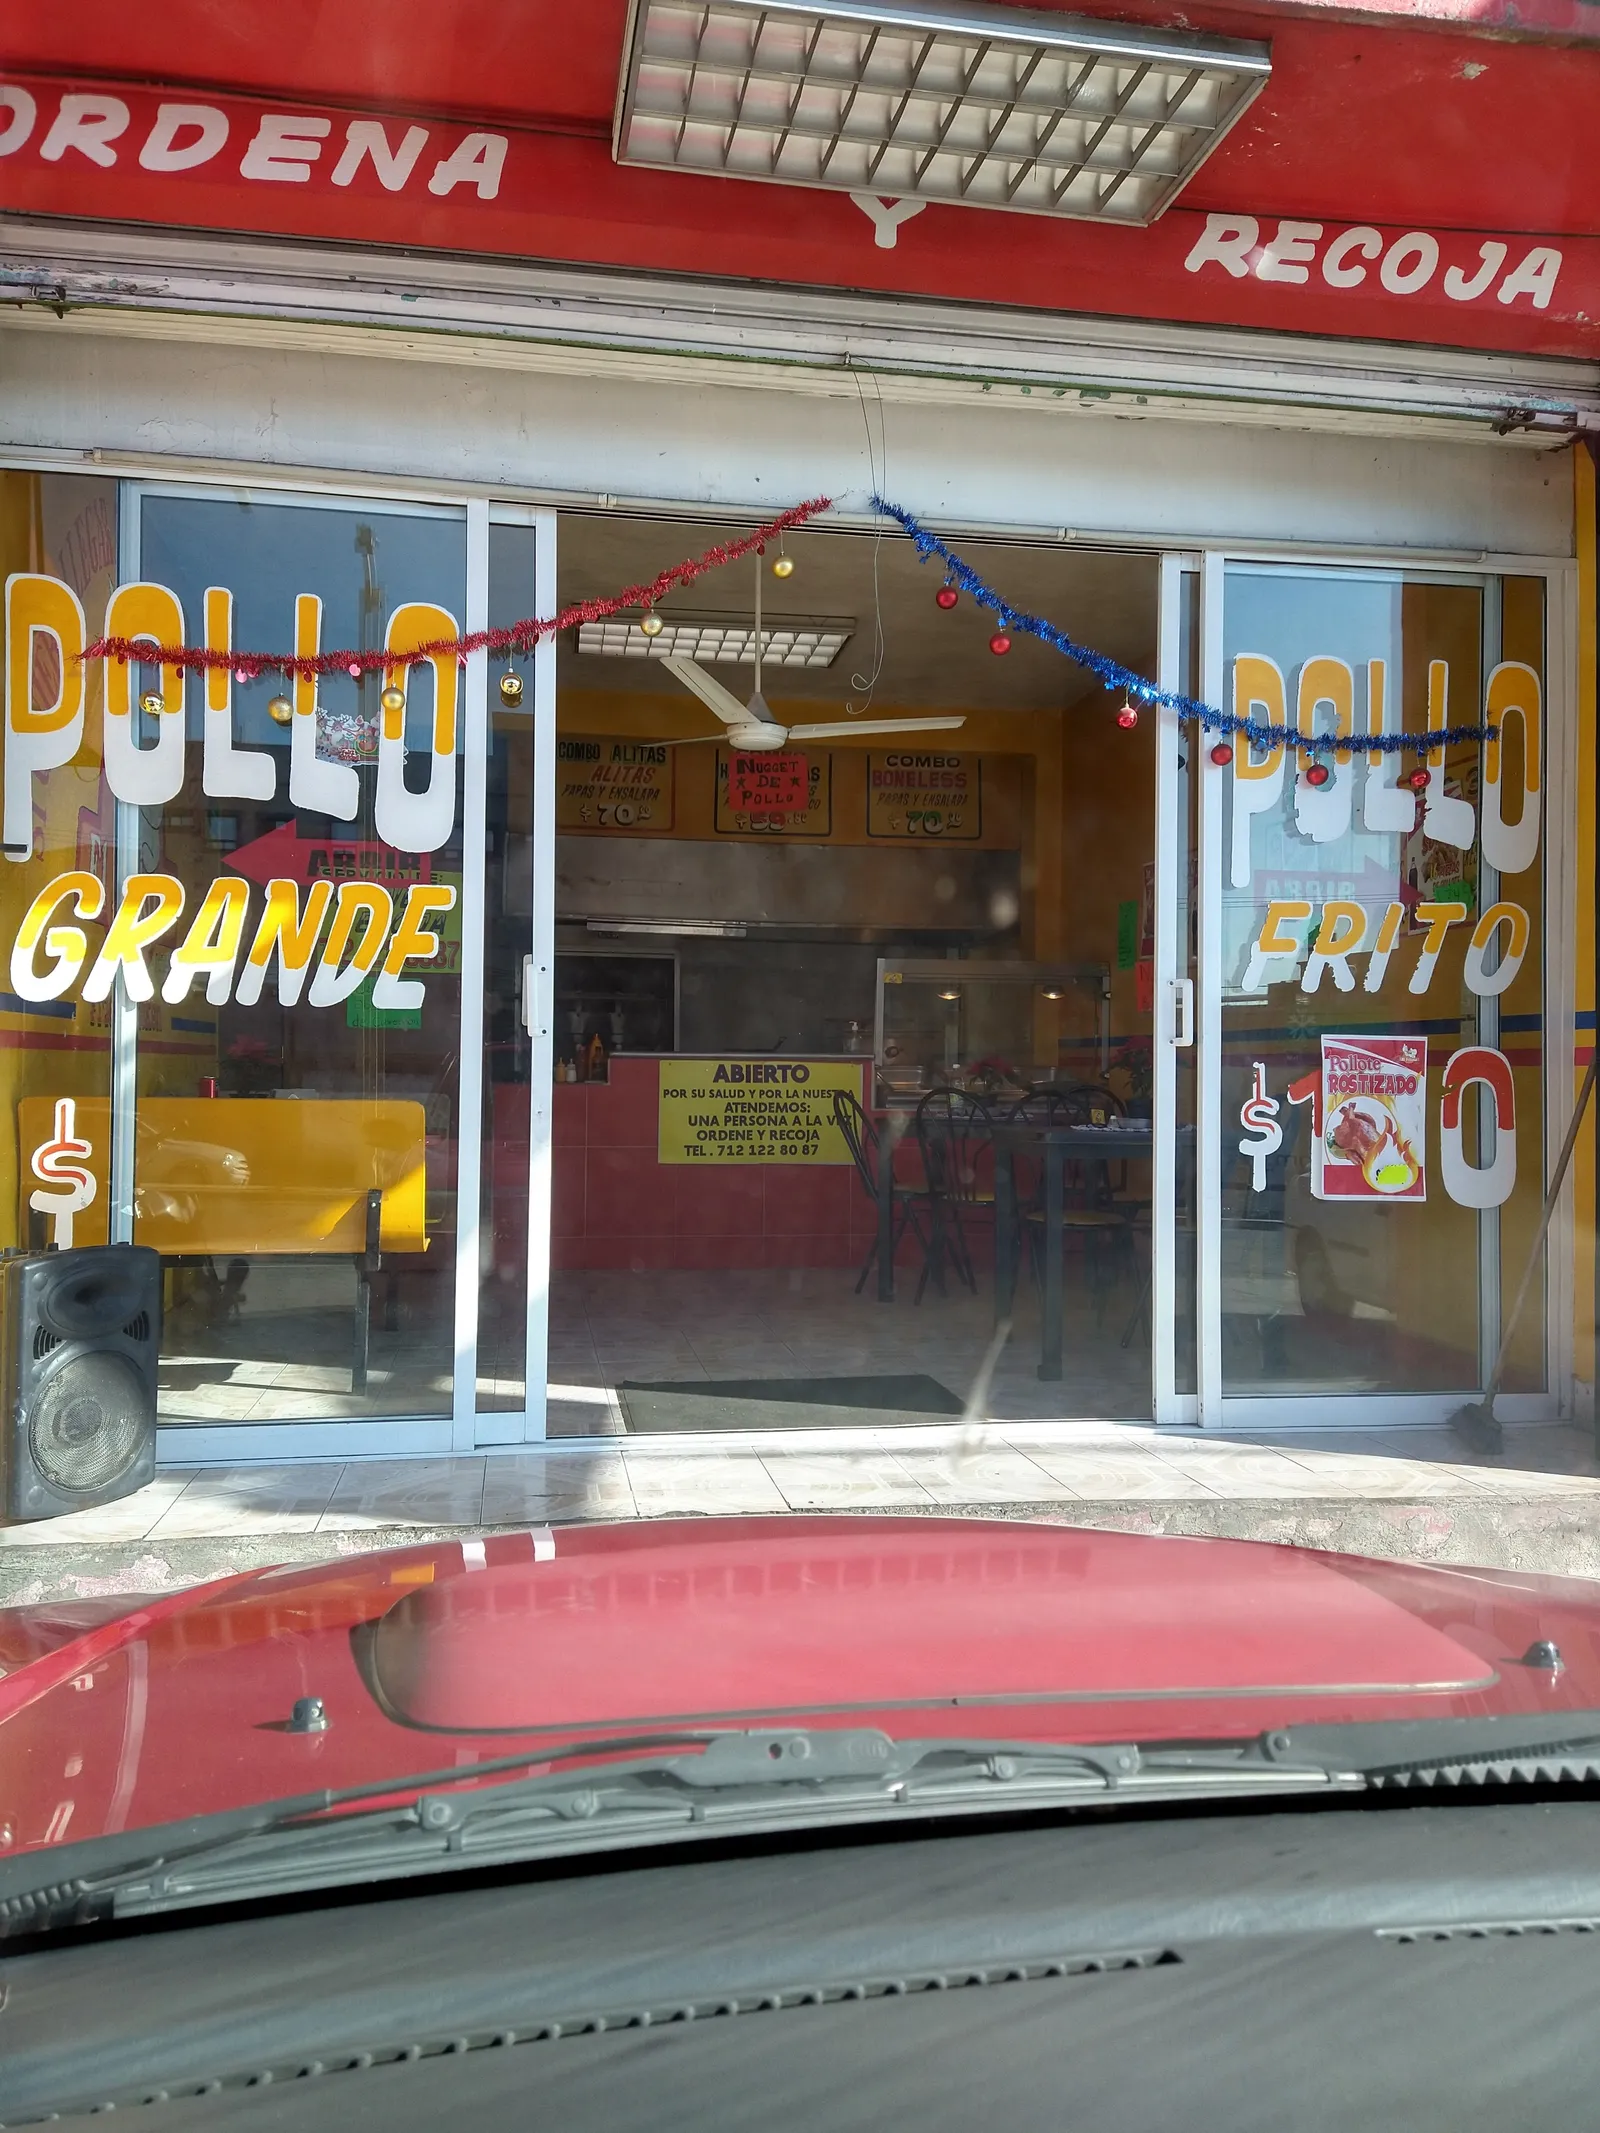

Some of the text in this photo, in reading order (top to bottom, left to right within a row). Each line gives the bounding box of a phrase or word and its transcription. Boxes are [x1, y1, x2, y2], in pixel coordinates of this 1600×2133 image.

[850, 191, 926, 249] Y
[1184, 212, 1563, 309] RECOJA
[4, 573, 460, 863] POLLO
[557, 741, 667, 763] COMBO ALITAS
[886, 754, 961, 769] COMBO
[590, 765, 656, 784] ALITAS
[736, 759, 799, 774] NUGGET
[1231, 653, 1542, 888] POLLO
[756, 775, 781, 788] DE
[872, 769, 968, 788] BONELESS
[742, 791, 794, 806] POLLO
[9, 871, 458, 1009] GRANDE
[1241, 901, 1531, 997] FRITO
[1328, 1054, 1382, 1073] Pollote
[713, 1064, 810, 1084] ABIERTO
[663, 1089, 687, 1099] POR
[691, 1089, 706, 1099] SU
[708, 1089, 745, 1099] SALUD
[749, 1089, 756, 1098] Y
[759, 1089, 783, 1099] POR
[786, 1089, 800, 1099] LA
[1327, 1073, 1419, 1096] ROSTIZADO
[724, 1102, 811, 1113] ATENDEMOS:
[688, 1115, 720, 1126] UNA
[724, 1115, 788, 1127] PERSONA
[792, 1115, 802, 1126] A
[806, 1115, 822, 1126] LA
[696, 1129, 820, 1143] ORDENE Y RECOJA
[717, 1145, 744, 1156] 712
[748, 1145, 775, 1156] 122
[780, 1145, 798, 1156] 80
[802, 1144, 819, 1156] 87
